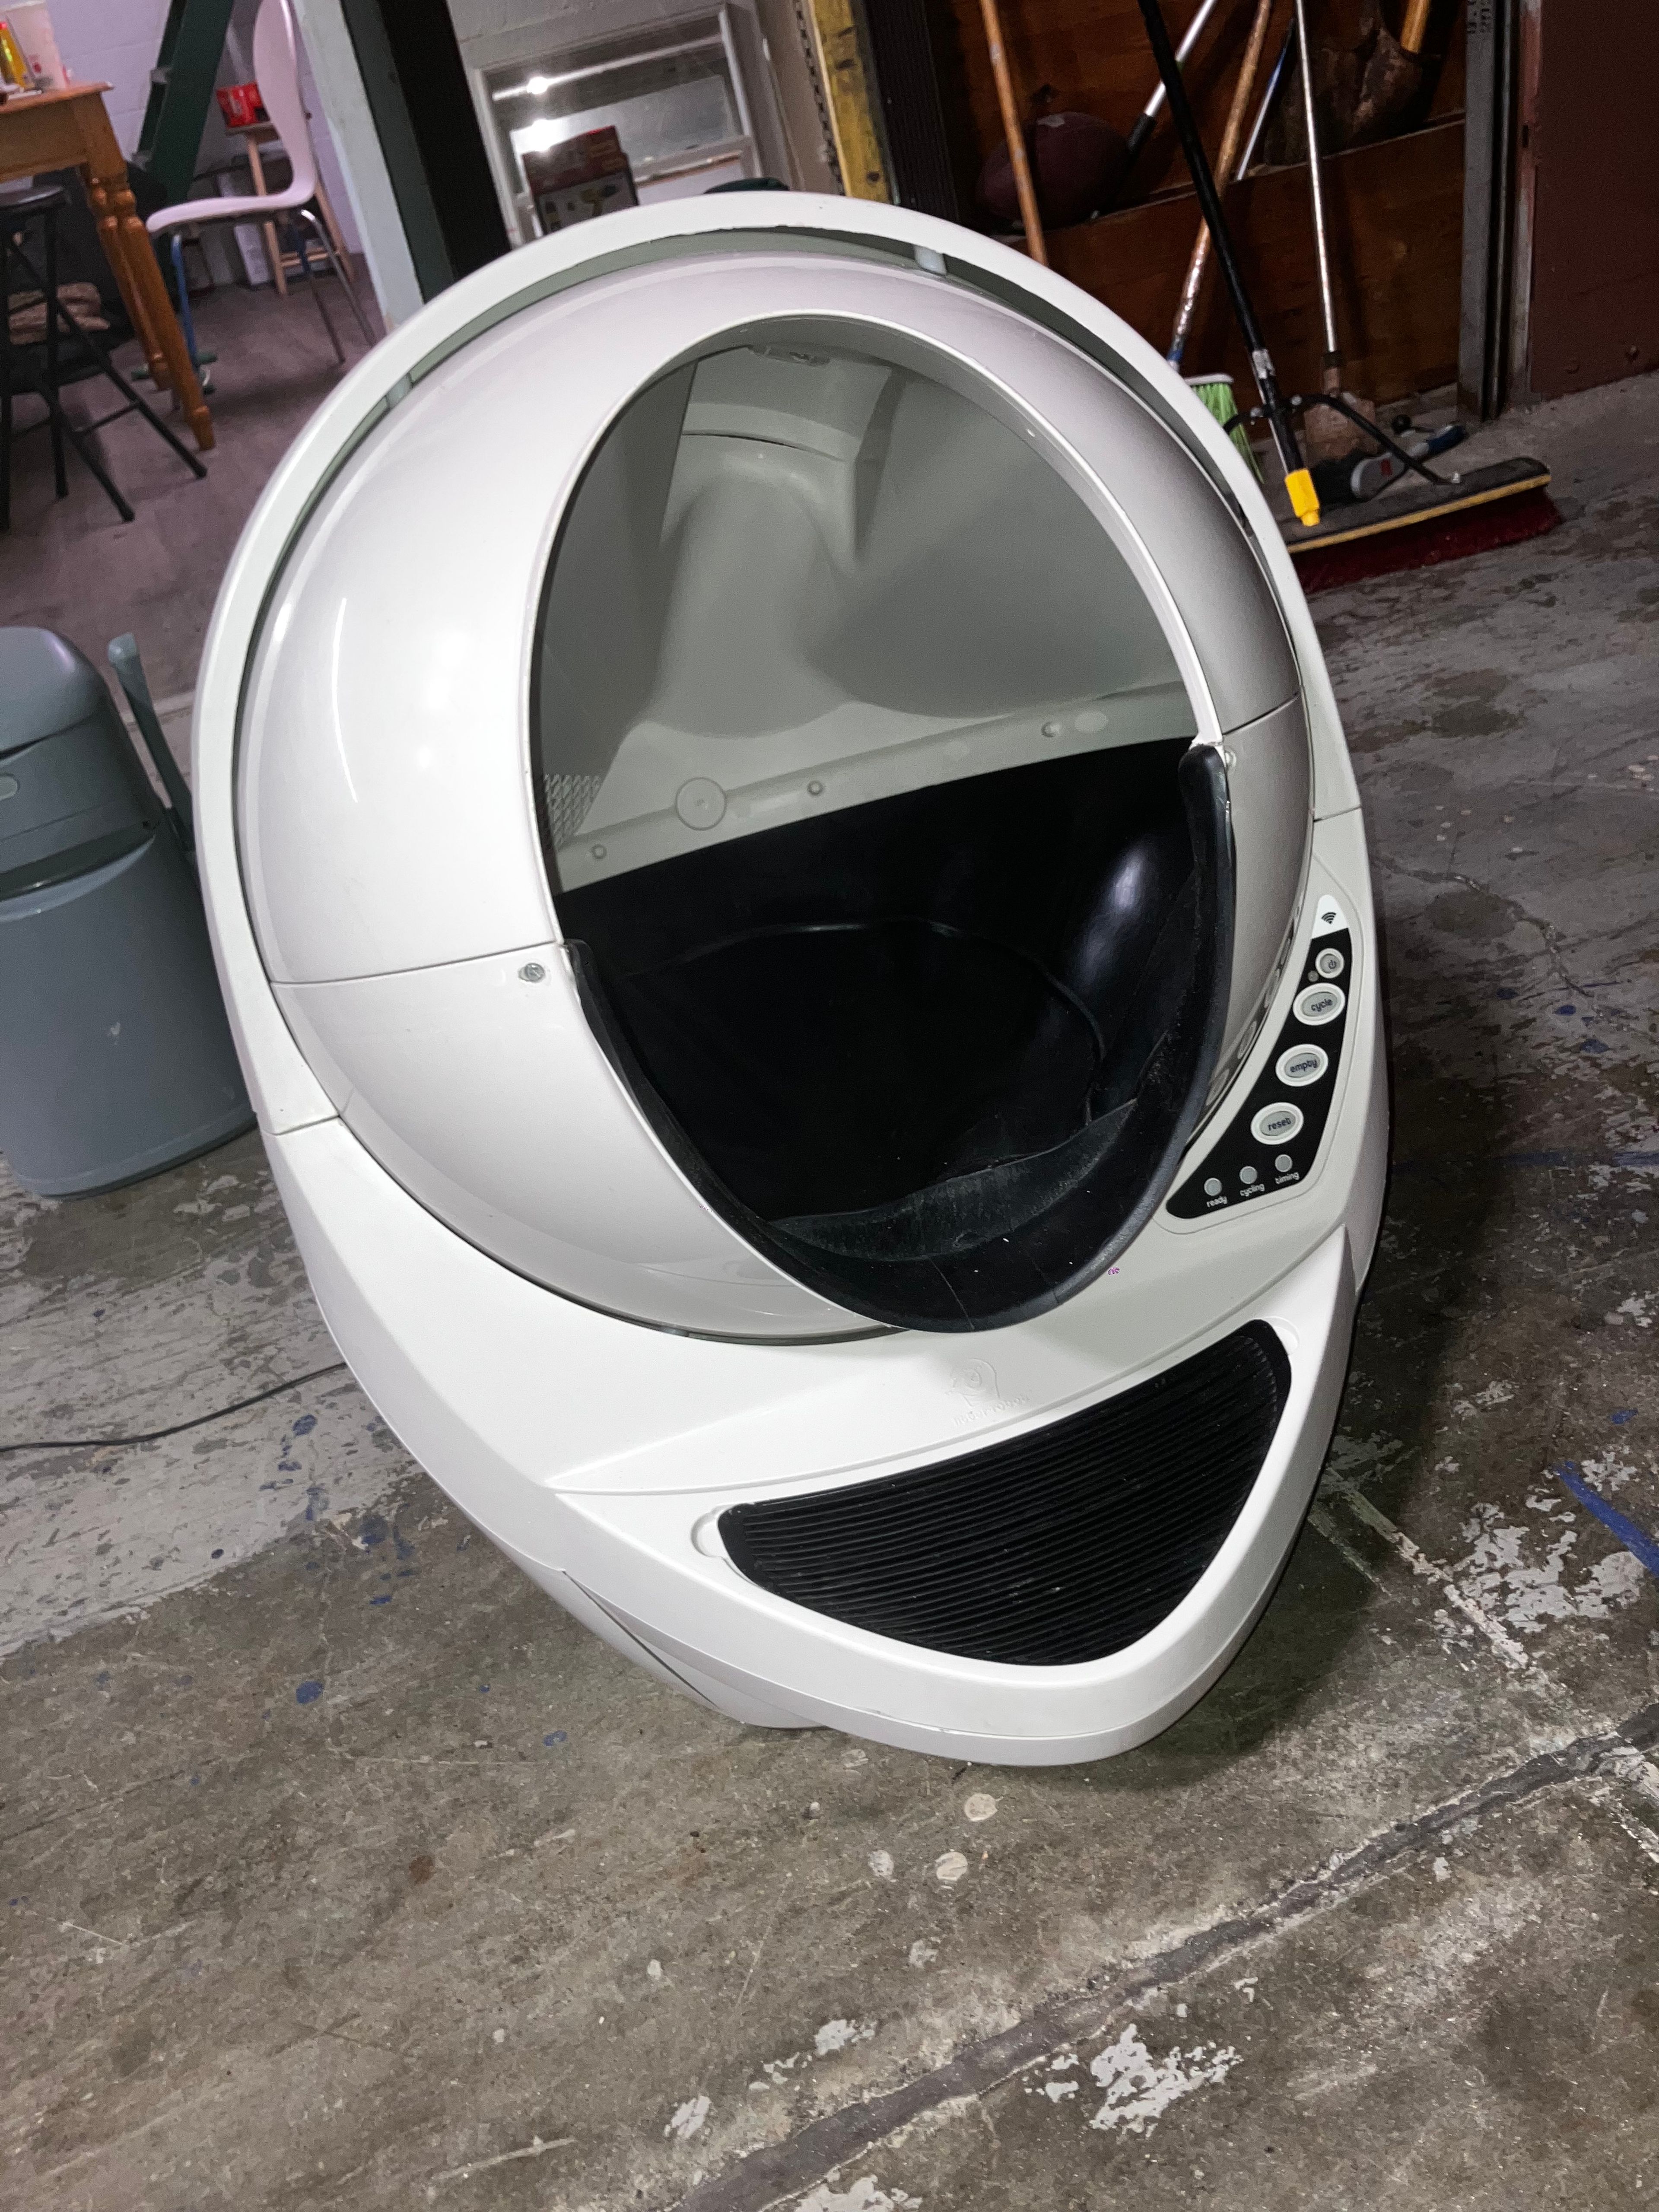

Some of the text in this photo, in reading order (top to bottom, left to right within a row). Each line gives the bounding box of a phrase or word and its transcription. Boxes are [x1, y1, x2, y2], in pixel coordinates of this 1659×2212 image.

[1310, 998, 1333, 1012] cycle
[1290, 1058, 1317, 1073] empty
[1268, 1117, 1292, 1131] reset
[1275, 1172, 1300, 1184] timing
[1239, 1183, 1265, 1197] cycling
[1206, 1196, 1228, 1208] ready
